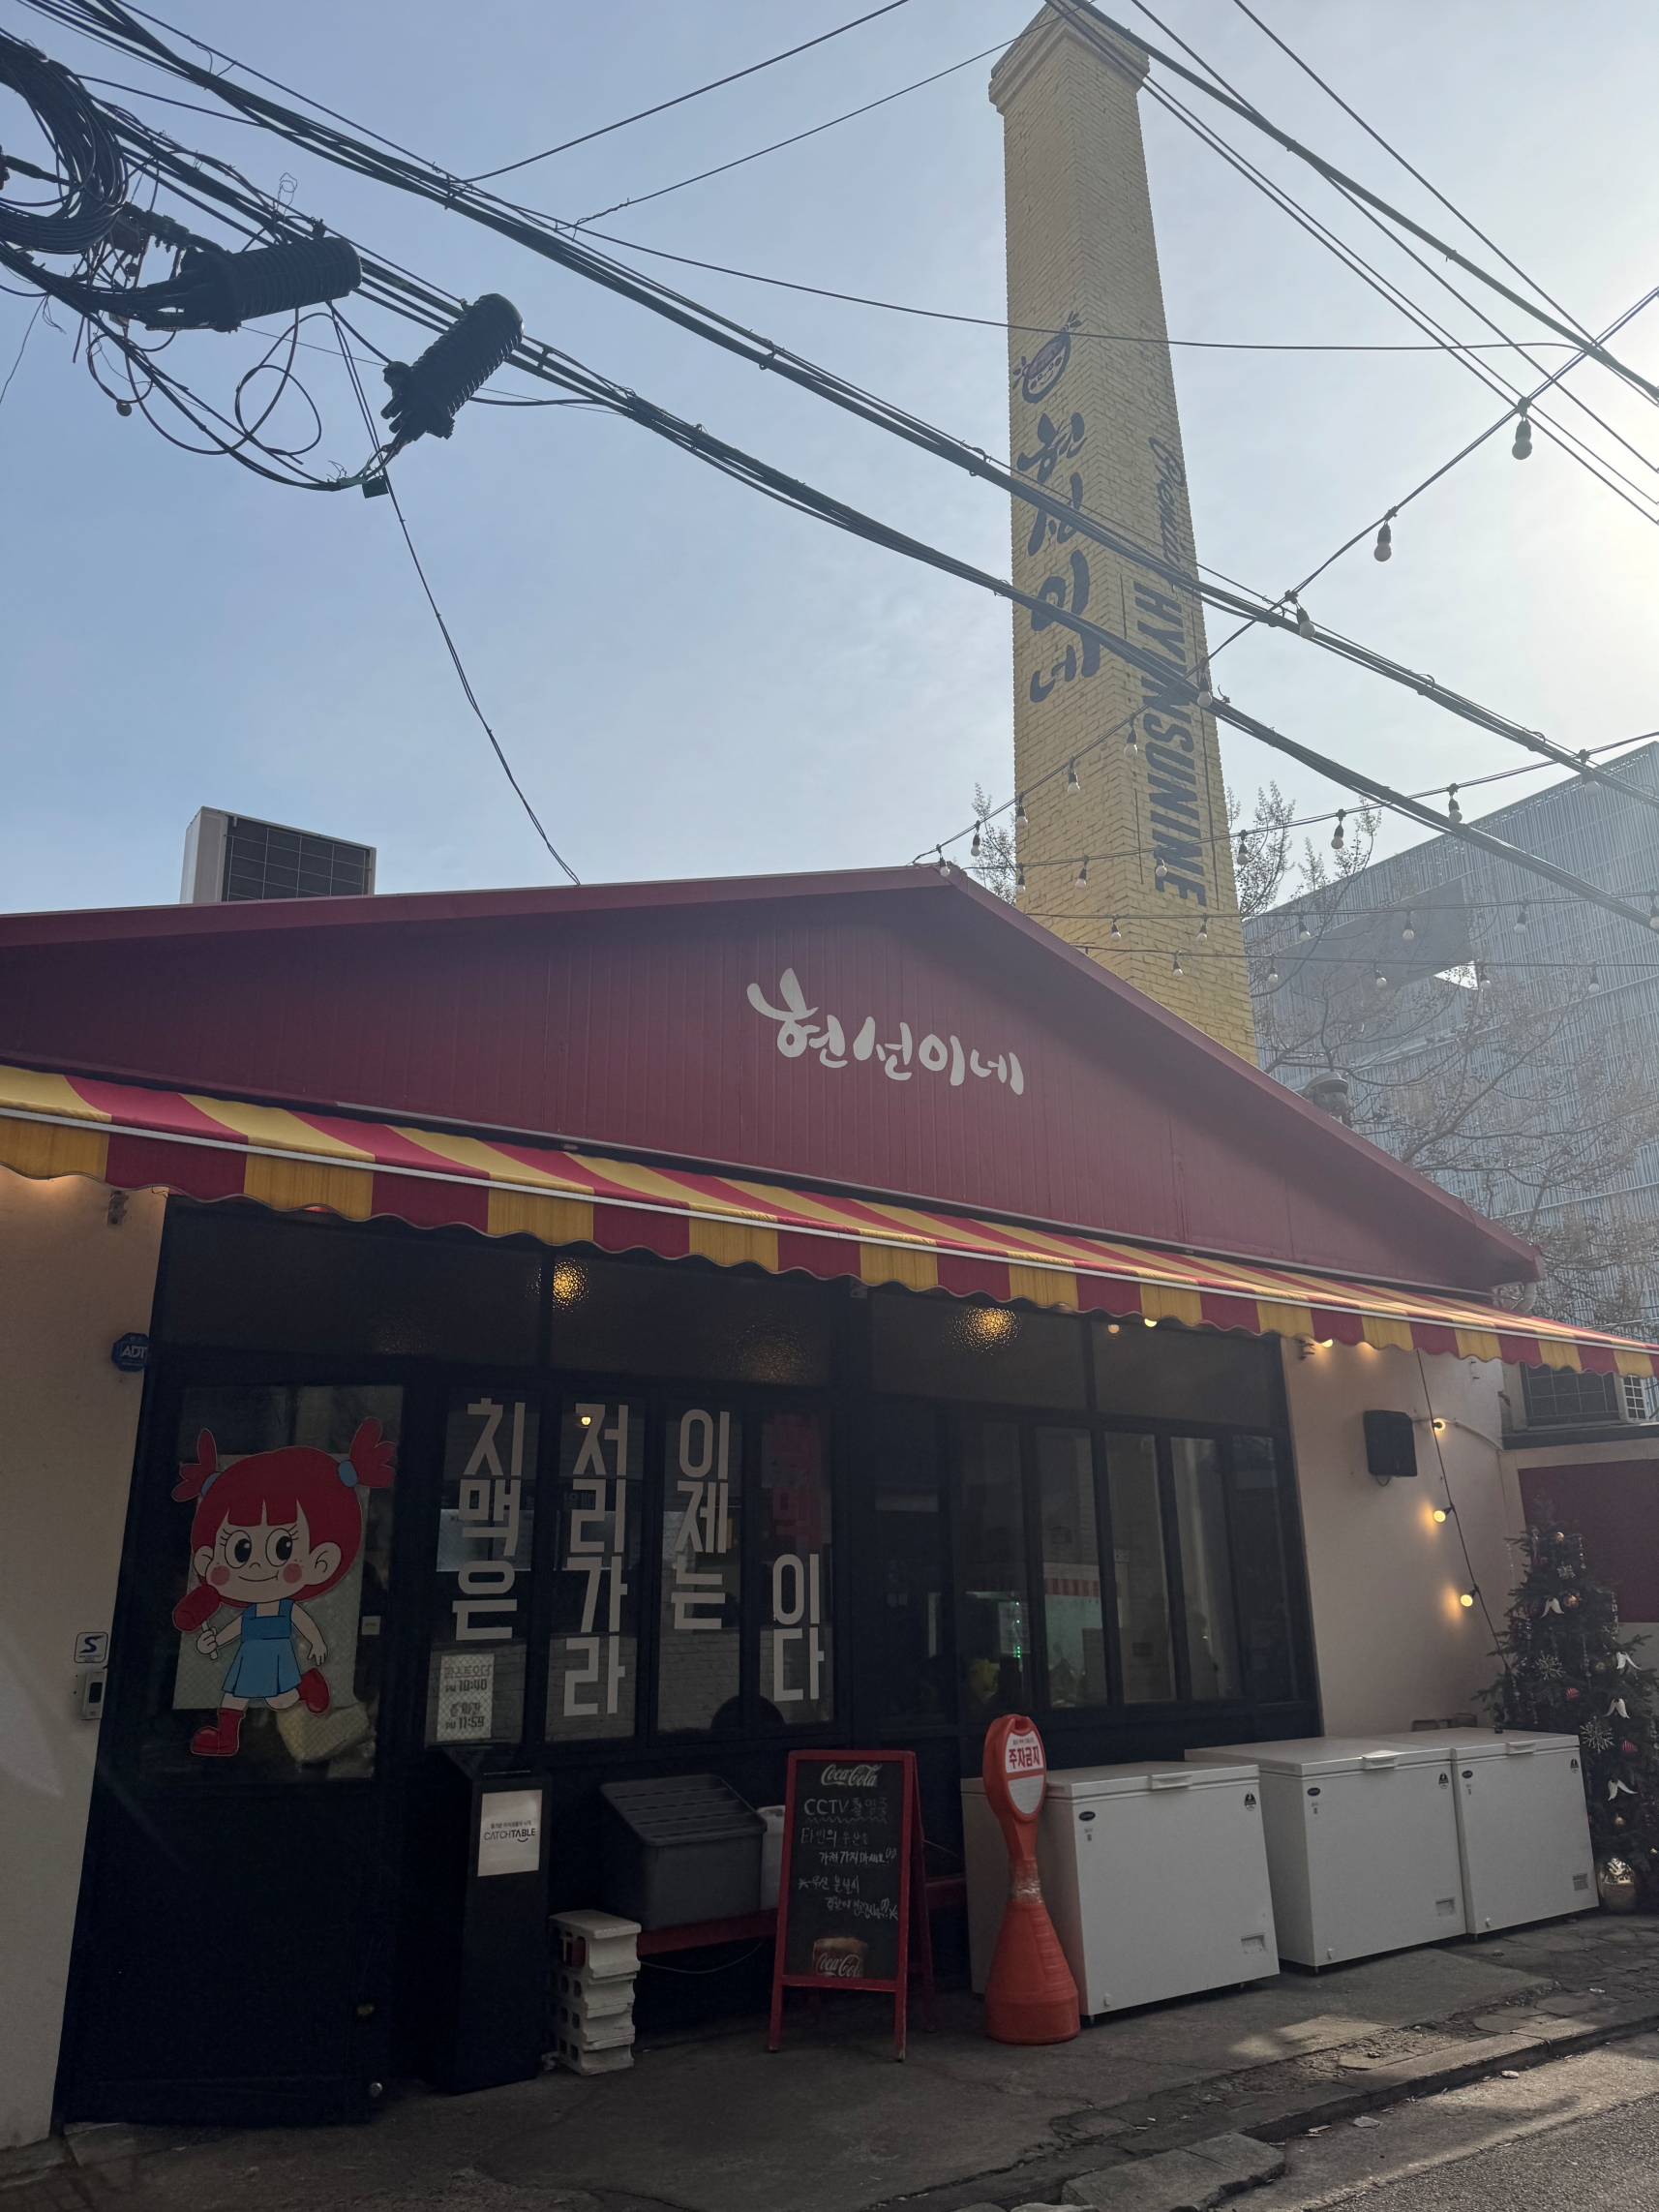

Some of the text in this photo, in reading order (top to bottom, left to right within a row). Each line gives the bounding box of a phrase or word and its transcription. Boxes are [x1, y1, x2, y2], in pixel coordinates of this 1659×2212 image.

[1016, 411, 1101, 703] 현선이네
[746, 968, 1024, 1095] 현선이네
[119, 1345, 148, 1359] ADT
[452, 1398, 526, 1640] 치맥은
[671, 1409, 731, 1630] 이제는
[563, 1403, 629, 1717] 저리가라
[458, 1679, 488, 1692] 10:40
[445, 1715, 485, 1730] PM 11:59
[1009, 1745, 1040, 1768] 주차금지
[821, 1763, 883, 1787] Coca-Cola
[803, 1798, 850, 1816] CCTV
[484, 1829, 535, 1841] CATCHTABLE
[800, 1827, 838, 1848] 타인의
